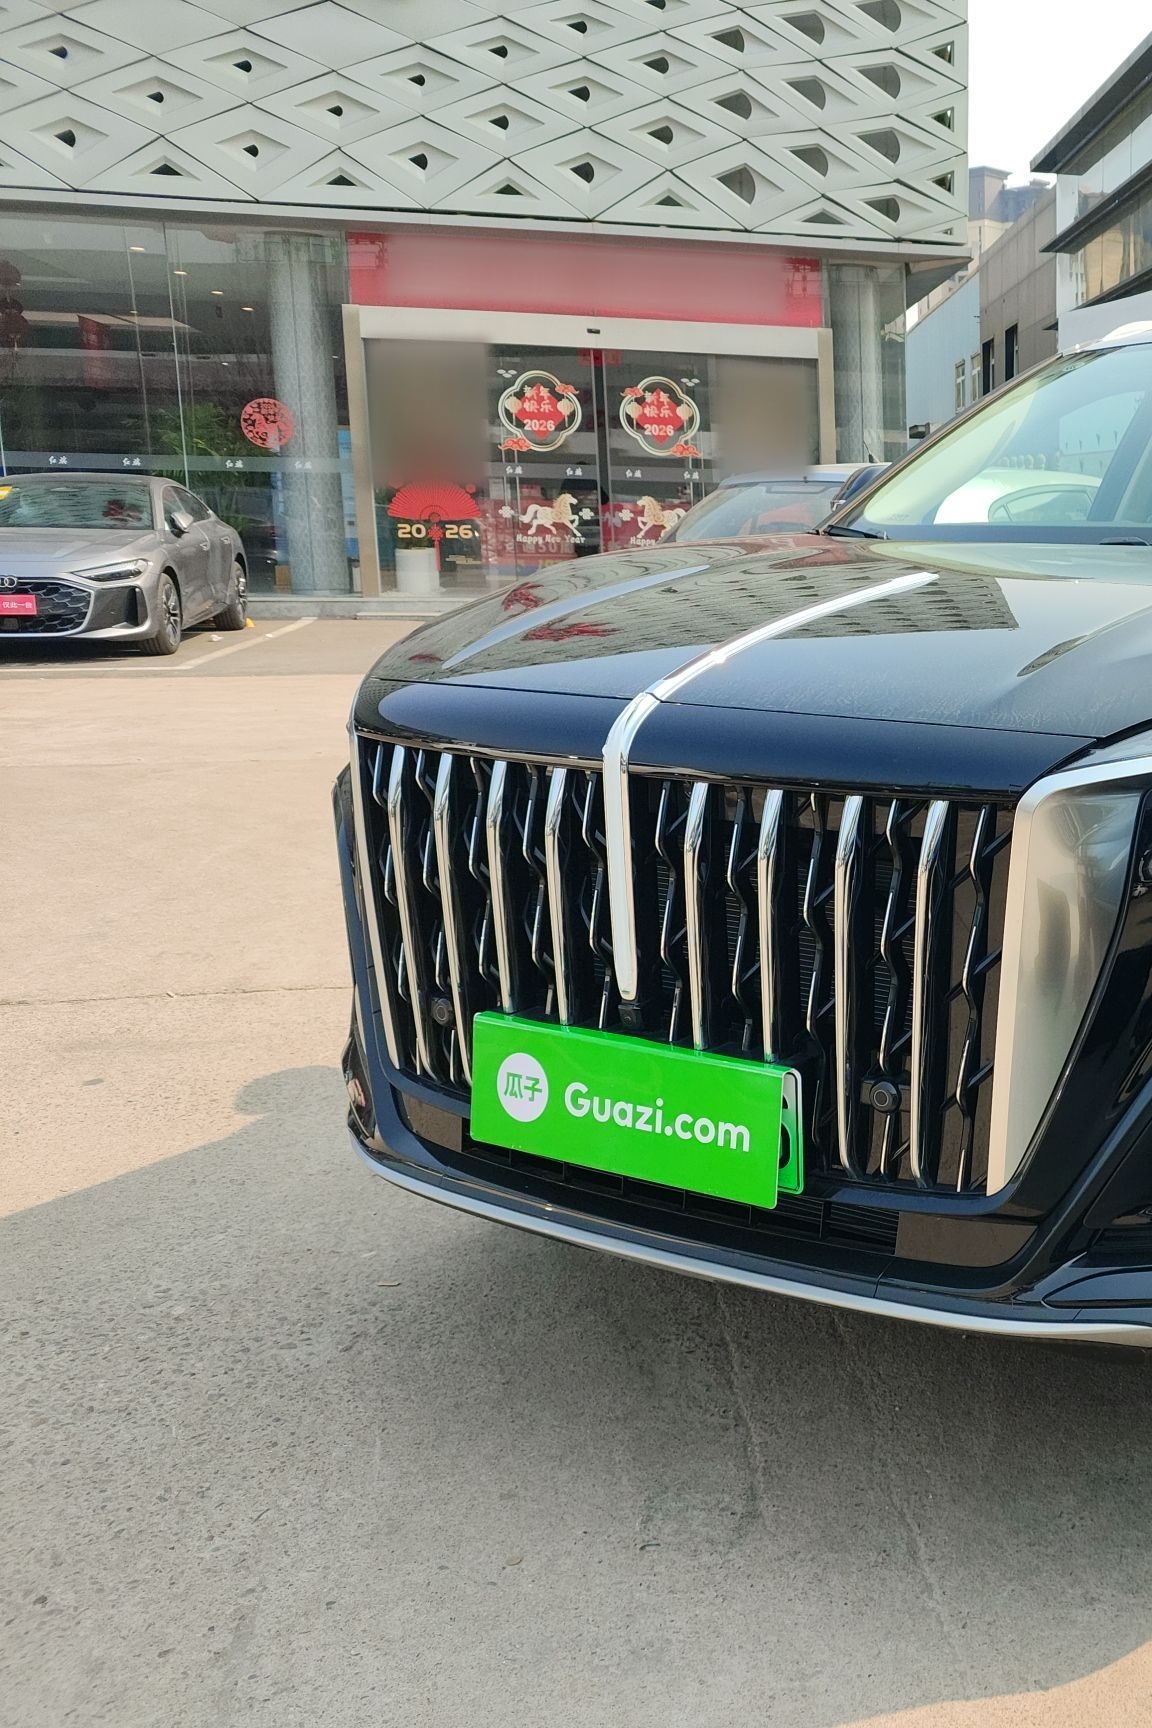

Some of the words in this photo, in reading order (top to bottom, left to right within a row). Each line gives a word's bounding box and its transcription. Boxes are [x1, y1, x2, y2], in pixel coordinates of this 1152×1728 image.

[523, 385, 550, 400] 新年
[643, 390, 670, 404] 新年
[523, 399, 554, 413] 快乐
[643, 404, 673, 418] 快乐
[523, 419, 556, 431] 2026
[643, 423, 674, 436] 2026
[516, 533, 543, 545] Happy
[545, 534, 561, 543] New
[564, 534, 586, 544] Year
[630, 536, 656, 547] Happy
[503, 1072, 543, 1102] 瓜子
[564, 1081, 750, 1152] Guazi.com
